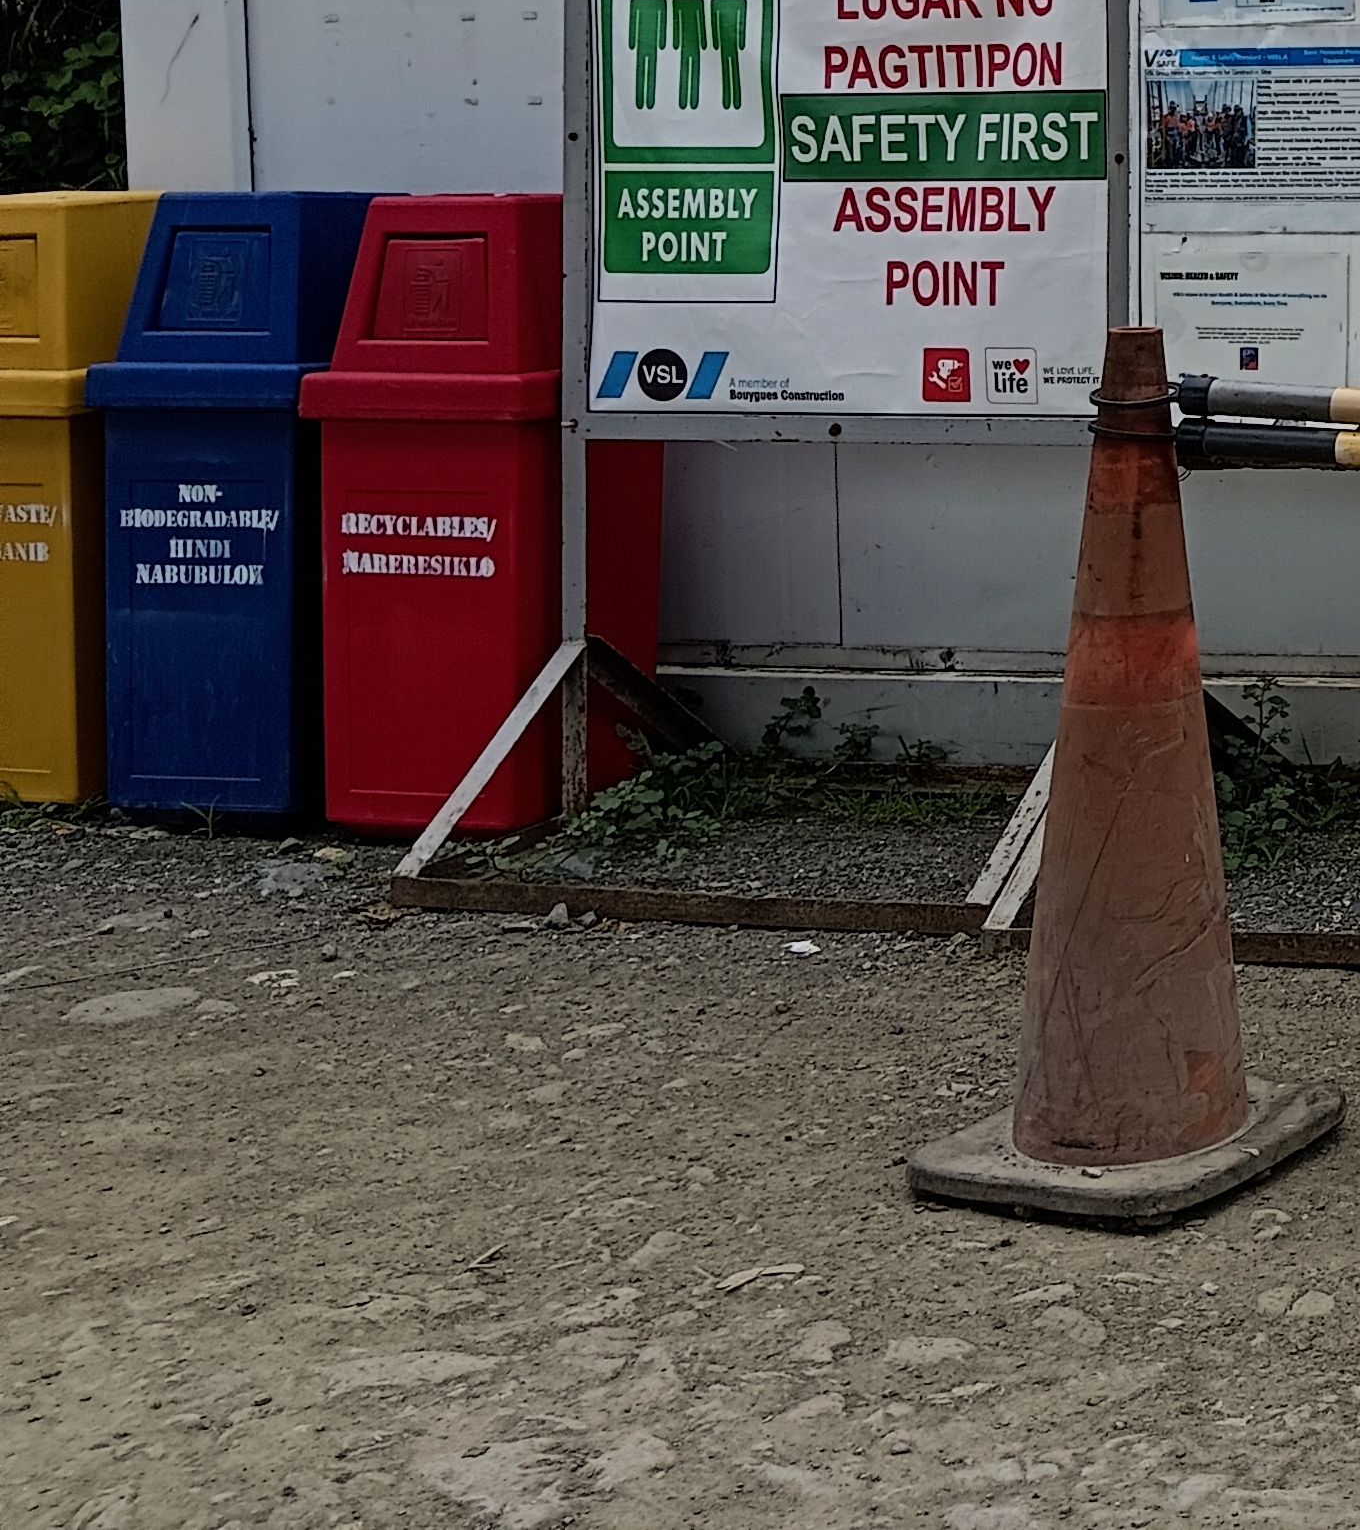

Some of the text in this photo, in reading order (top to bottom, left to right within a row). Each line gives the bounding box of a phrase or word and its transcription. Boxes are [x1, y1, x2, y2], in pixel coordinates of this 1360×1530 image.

[824, 42, 1063, 89] PAGTITIPON
[791, 112, 1098, 163] SAFETY FIRST
[617, 187, 758, 219] ASSEMBLY
[833, 187, 1057, 232] ASSEMBLY
[642, 231, 728, 262] POINT
[886, 261, 1005, 306] POINT
[1215, 272, 1239, 280] SAFETY
[642, 365, 684, 384] VSL
[729, 378, 790, 388] A member of
[992, 360, 1029, 394] we life
[1043, 367, 1054, 375] WE
[1057, 367, 1076, 375] LOVE
[1043, 376, 1055, 384] WE
[1057, 376, 1091, 384] PROTECT
[730, 389, 845, 402] Bouygues Construction
[178, 484, 223, 503] NON-
[0, 504, 57, 528] ASTE/
[119, 509, 280, 532] BIODEGRADABLE/
[341, 512, 497, 543] RECYCLABLES/
[170, 536, 232, 559] HINDI
[342, 549, 496, 578] NARERESIKLO
